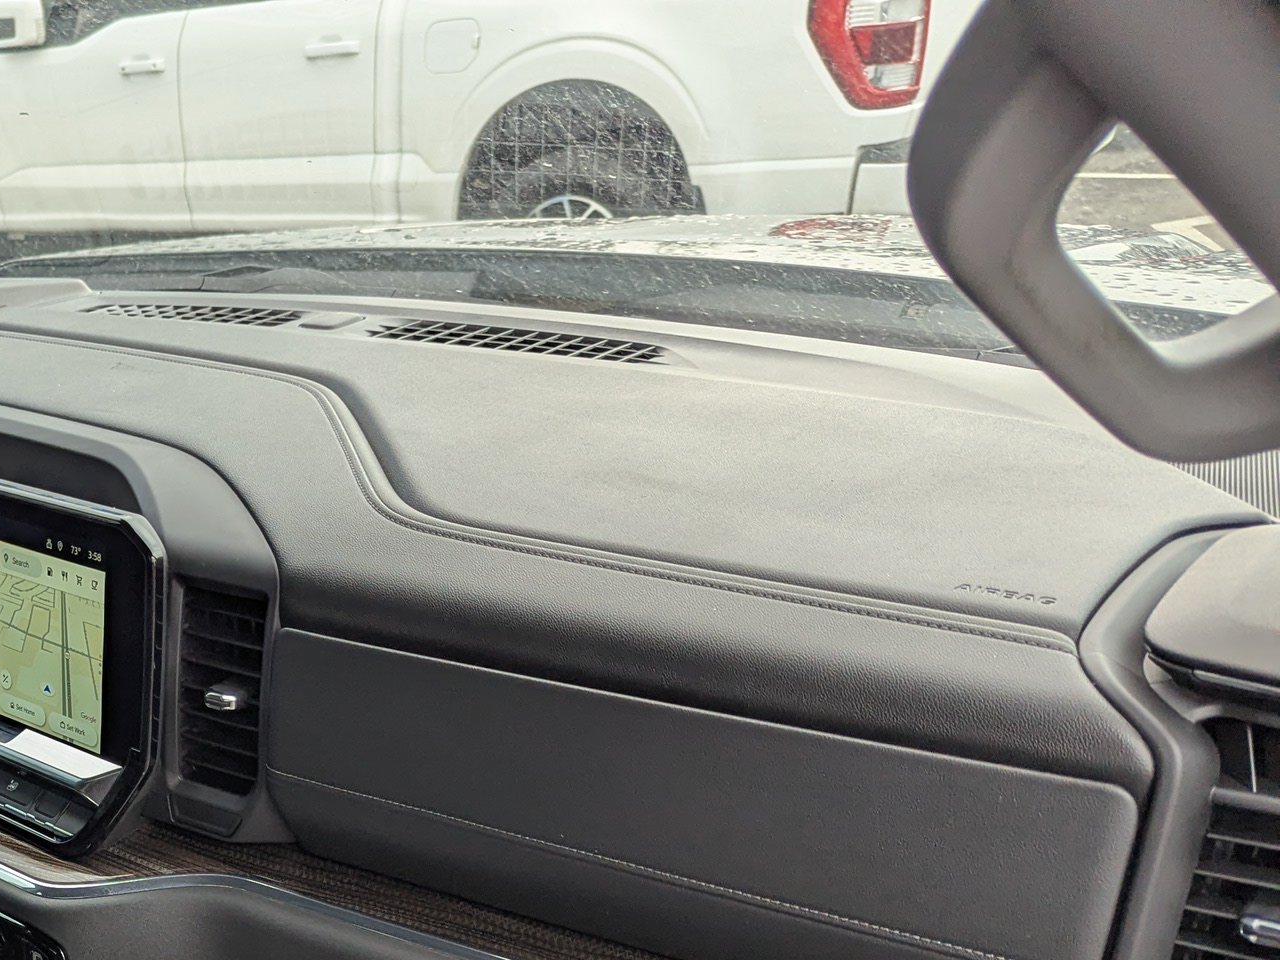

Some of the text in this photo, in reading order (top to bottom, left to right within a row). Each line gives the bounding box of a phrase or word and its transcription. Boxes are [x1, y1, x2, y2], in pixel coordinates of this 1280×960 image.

[12, 556, 30, 568] Search
[87, 550, 102, 562] 3:58
[953, 583, 1058, 606] AIRBAG
[23, 705, 36, 717] Home
[80, 711, 97, 724] Google
[74, 725, 86, 737] Work
